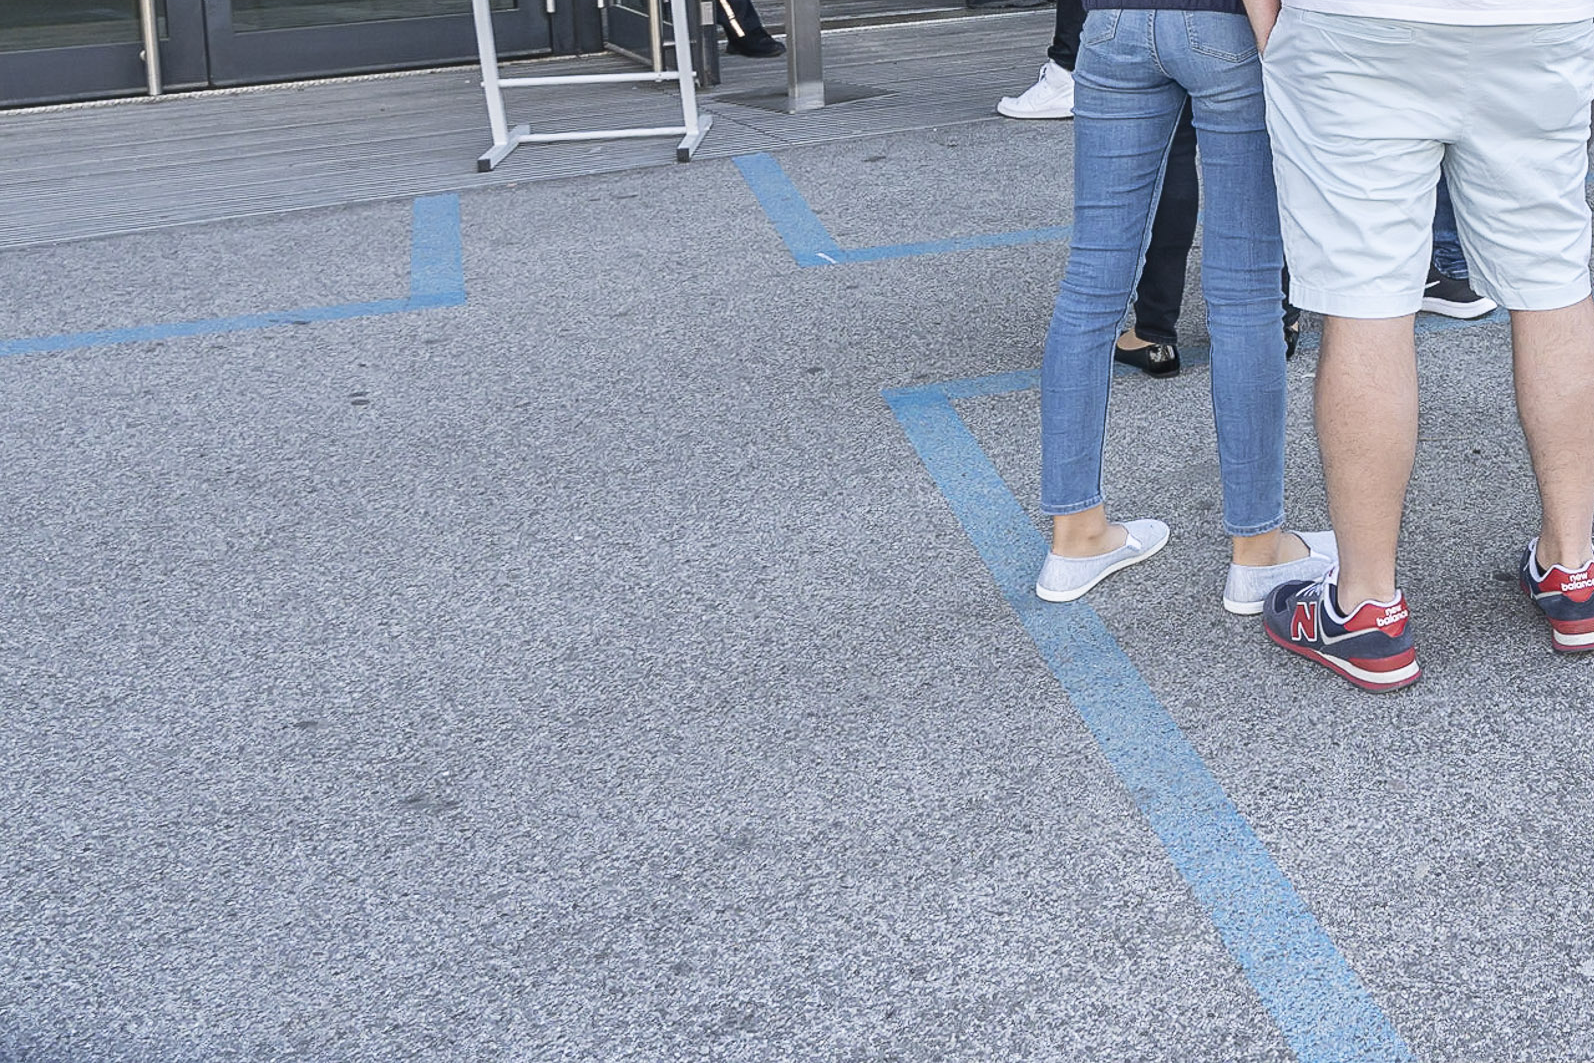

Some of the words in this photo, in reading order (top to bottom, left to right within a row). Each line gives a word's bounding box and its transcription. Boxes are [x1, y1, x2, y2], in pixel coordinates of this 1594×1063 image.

[1569, 572, 1588, 582] new
[1384, 604, 1402, 617] new
[1291, 601, 1318, 643] N
